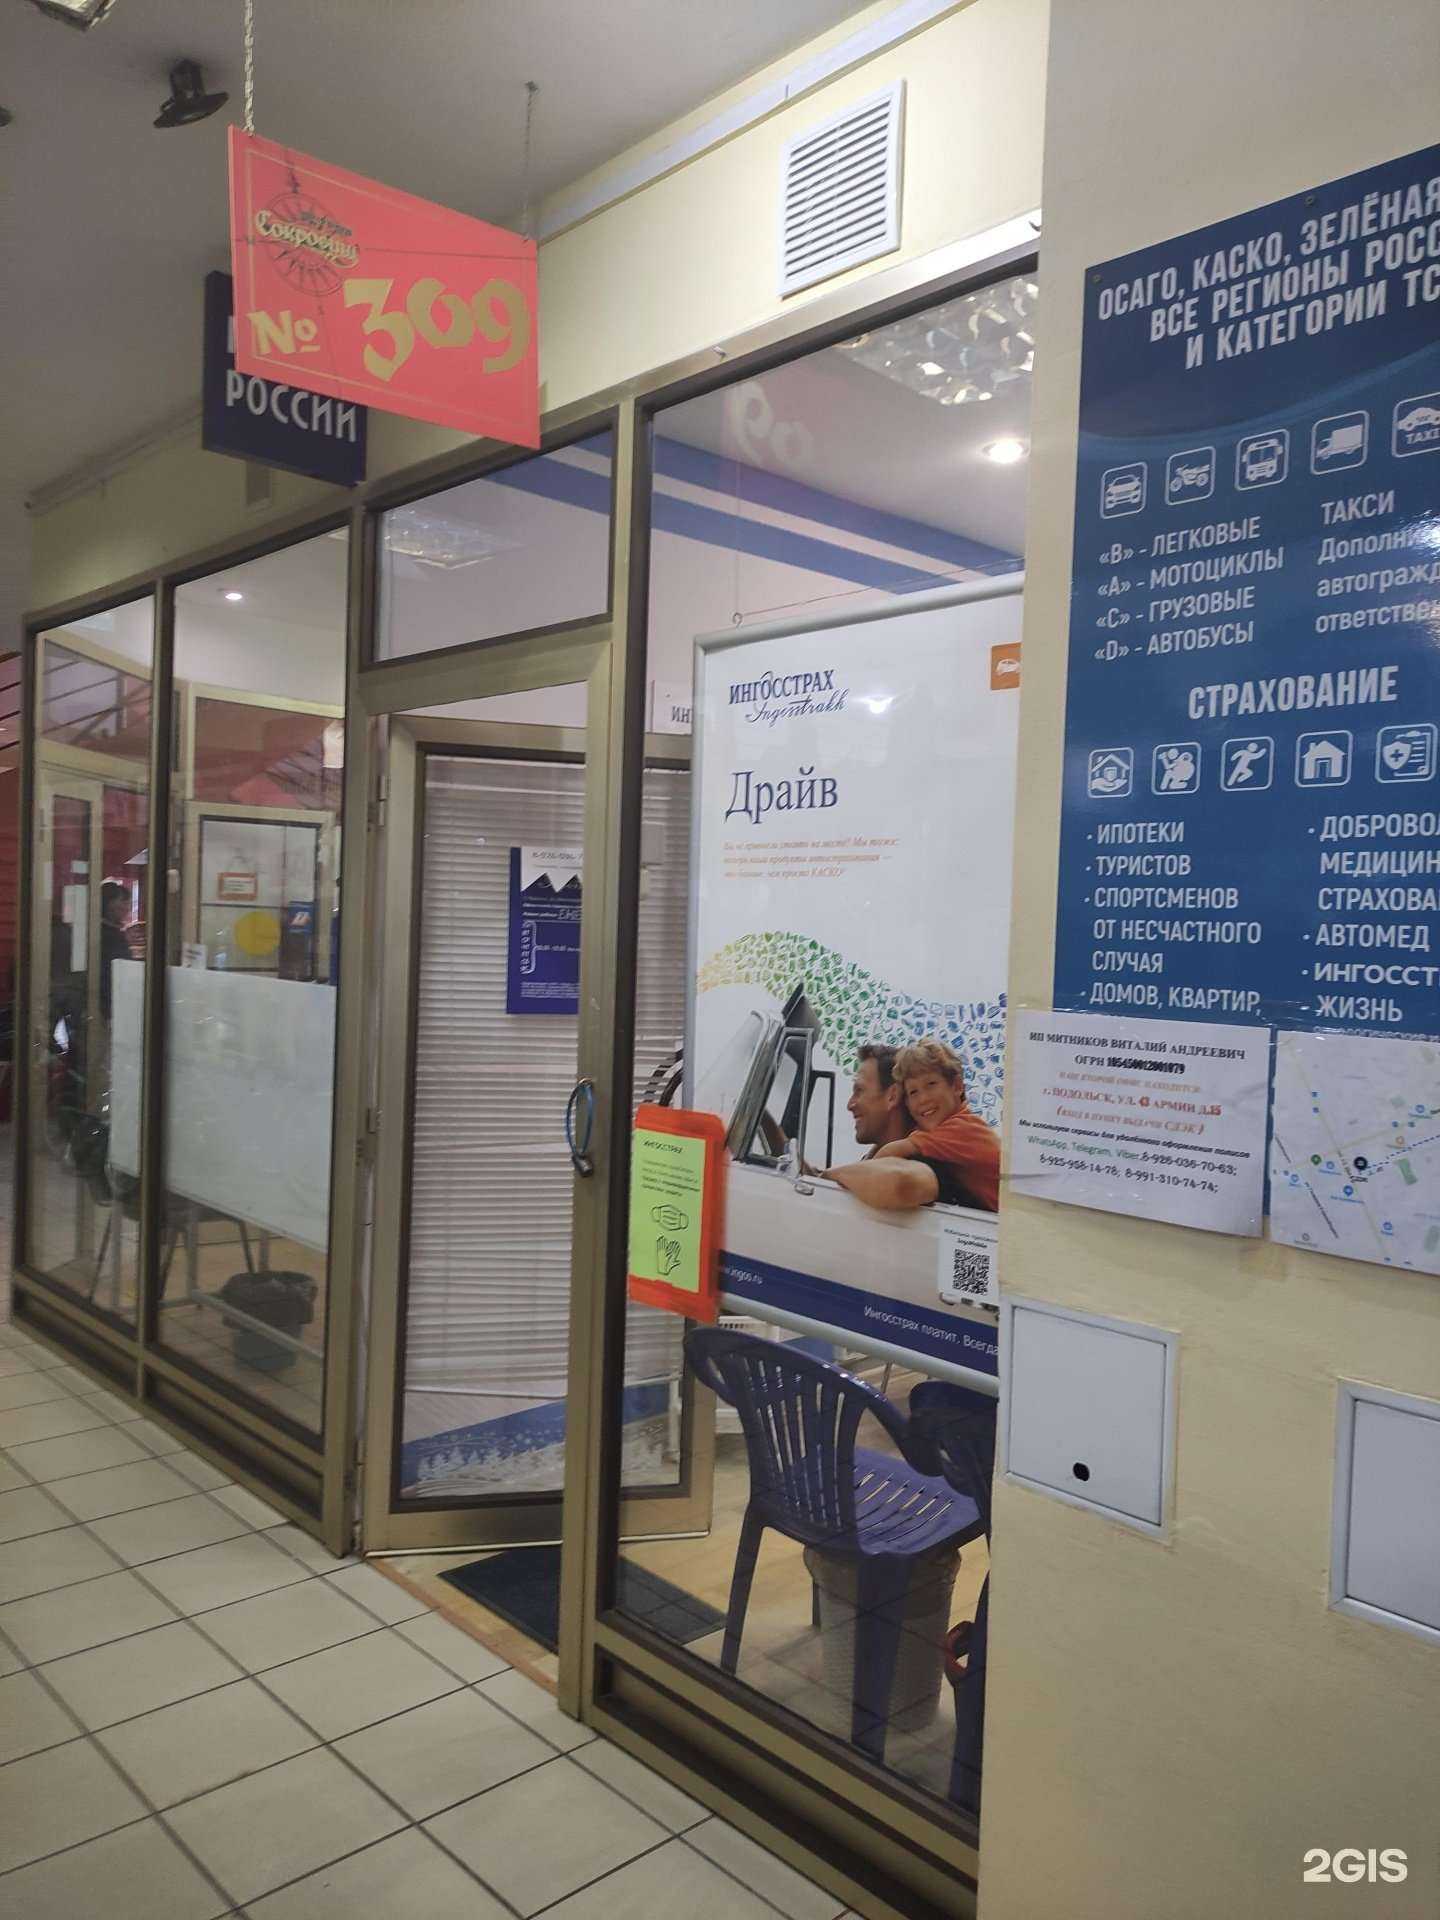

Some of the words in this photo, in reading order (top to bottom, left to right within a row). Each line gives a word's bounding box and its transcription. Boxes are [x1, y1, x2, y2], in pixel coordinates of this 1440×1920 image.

[1099, 267, 1185, 321] ОСАГО,
[1192, 232, 1291, 291] КАСКО,
[1300, 176, 1440, 255] ЗЕЛЁНАЯ
[1150, 297, 1200, 342] ВСЕ
[1211, 250, 1349, 324] РЕГИОНЫ
[343, 277, 532, 382] 309
[1185, 334, 1204, 370] И
[1216, 280, 1388, 361] КАТЕГОРИИ
[1403, 263, 1440, 308] ТС
[227, 369, 357, 442] РОССИИ
[1321, 490, 1396, 526] ТАКСИ
[1151, 516, 1262, 558] ЛЕГКОВЫЕ
[1149, 547, 1284, 590] МОТОЦИКЛЫ
[1148, 587, 1256, 623] ГРУЗОВЫЕ
[1094, 640, 1129, 661] «D»
[1147, 621, 1254, 656] АВТОБУСЫ
[728, 669, 835, 705] ИНГОССТРАХ
[1188, 665, 1400, 719] СТРАХОВАНИЕ
[725, 766, 838, 825] Драйв
[1097, 821, 1185, 845] ИПОТЕКИ
[1096, 855, 1192, 876] ТУРИСТОВ
[1094, 887, 1239, 910] СПОРТСМЕНОВ
[1093, 919, 1116, 940] ОТ
[1121, 919, 1262, 944] НЕСЧАСТНОГО
[1315, 923, 1430, 952] АВТОМЕД
[1092, 951, 1164, 973] СЛУЧАЯ
[1090, 982, 1162, 1009] ДОМОВ,
[1168, 986, 1263, 1016] КВАРТИР,
[1316, 994, 1403, 1022] ЖИЗНЬ
[1029, 1031, 1045, 1042] ИП
[1046, 1034, 1108, 1048] МИТНИКОВ
[1110, 1040, 1167, 1053] ВИТАЛИЙ
[1170, 1045, 1245, 1060] АНДРЕЕВИЧ
[1075, 1054, 1104, 1067] ОГРН
[1152, 1100, 1196, 1113] АРМИИ
